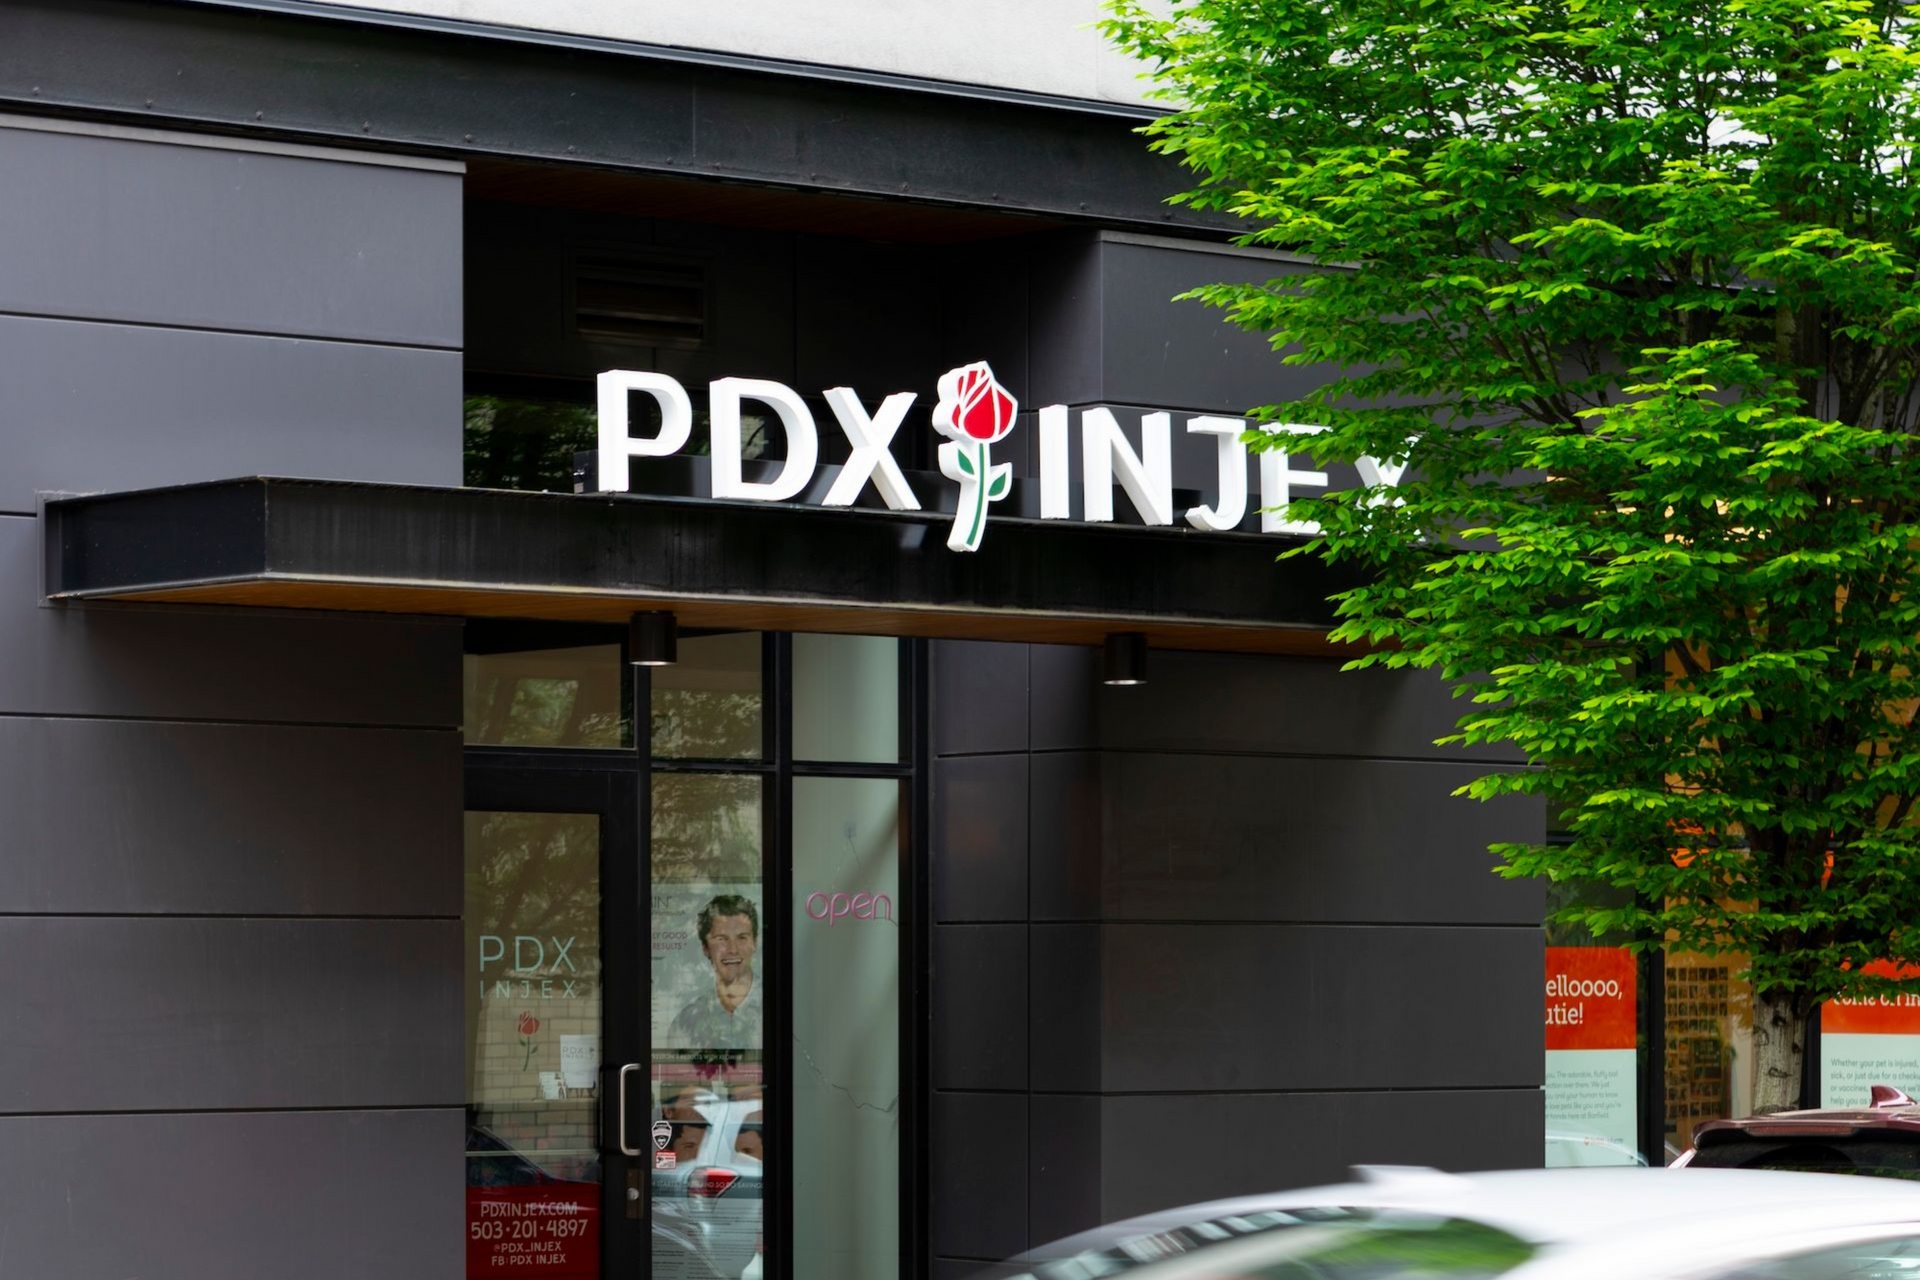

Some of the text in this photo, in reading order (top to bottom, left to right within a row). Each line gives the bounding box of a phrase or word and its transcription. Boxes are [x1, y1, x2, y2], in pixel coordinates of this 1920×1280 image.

[596, 369, 922, 511] PDX
[806, 891, 891, 926] open
[662, 931, 688, 940] GOOD
[479, 935, 576, 972] PDX
[480, 980, 576, 999] INJEX
[1831, 1059, 1858, 1067] Whether
[1860, 1061, 1874, 1069] your
[1876, 1060, 1886, 1068] pet
[1854, 1072, 1866, 1081] just
[1830, 1097, 1844, 1106] help
[1845, 1098, 1858, 1107] you
[480, 1202, 578, 1217] PDXINJEX.COM
[536, 1254, 566, 1264] INJEX
